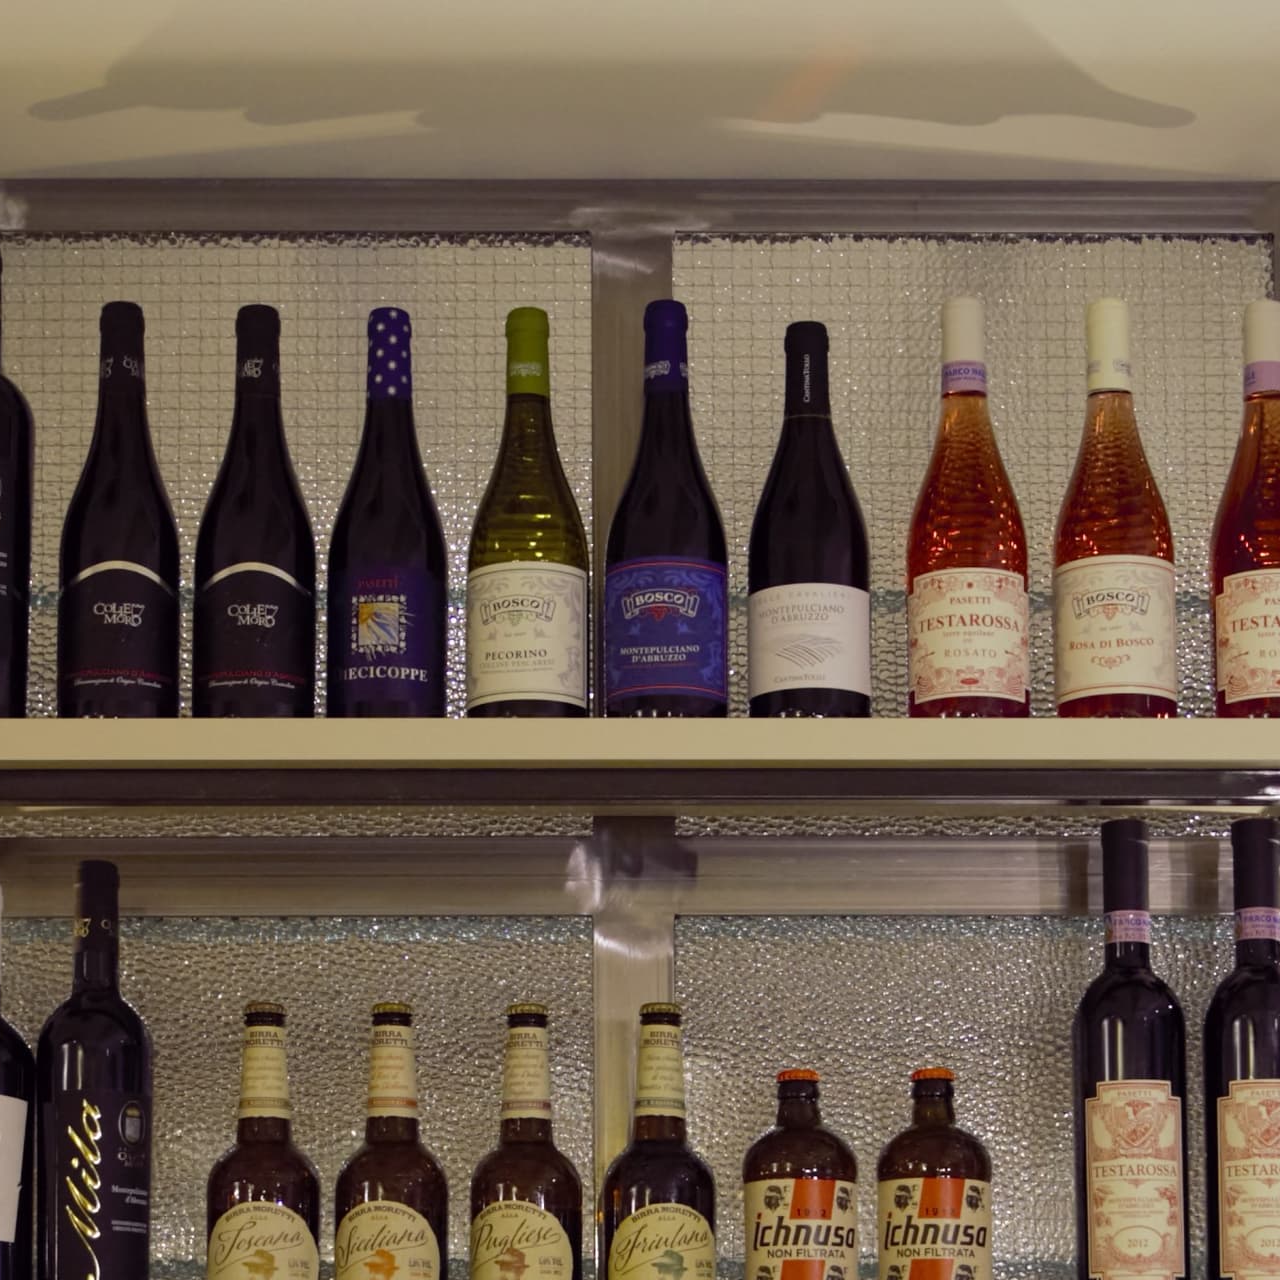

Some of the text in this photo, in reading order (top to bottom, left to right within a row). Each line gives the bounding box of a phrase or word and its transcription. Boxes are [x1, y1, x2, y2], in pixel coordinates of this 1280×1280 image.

[492, 598, 540, 611] BOSCO
[634, 591, 685, 606] BOSCO
[949, 595, 992, 605] PASETTI
[1086, 591, 1135, 605] BOSCO
[760, 602, 845, 618] MONTEPULCIANO
[919, 613, 1019, 633] TESTAROSSA
[620, 644, 700, 656] MONTEPULCIANO
[1069, 637, 1154, 651] ROSA DI BOSCO
[485, 648, 548, 661] PECORINO
[631, 653, 687, 663] D'ABRUZZO
[944, 648, 997, 658] ROSATO
[343, 665, 428, 682] IECICOPPE
[1093, 1163, 1177, 1179] TESTAROSSA
[225, 1205, 296, 1223] BIRRA MORETTI
[347, 1205, 417, 1223] BIRRA MORETTI
[480, 1204, 547, 1220] BIRRA MORETTI
[631, 1206, 702, 1224] BIRRA MORETTI
[215, 1220, 304, 1266] Toscana
[337, 1223, 429, 1269] Siciliana
[473, 1218, 561, 1261] Pugliese
[615, 1222, 709, 1272] Friulana
[1127, 1238, 1149, 1249] 2012
[767, 1248, 846, 1259] NON FILTRATA
[896, 1247, 976, 1259] NON FILTRATA
